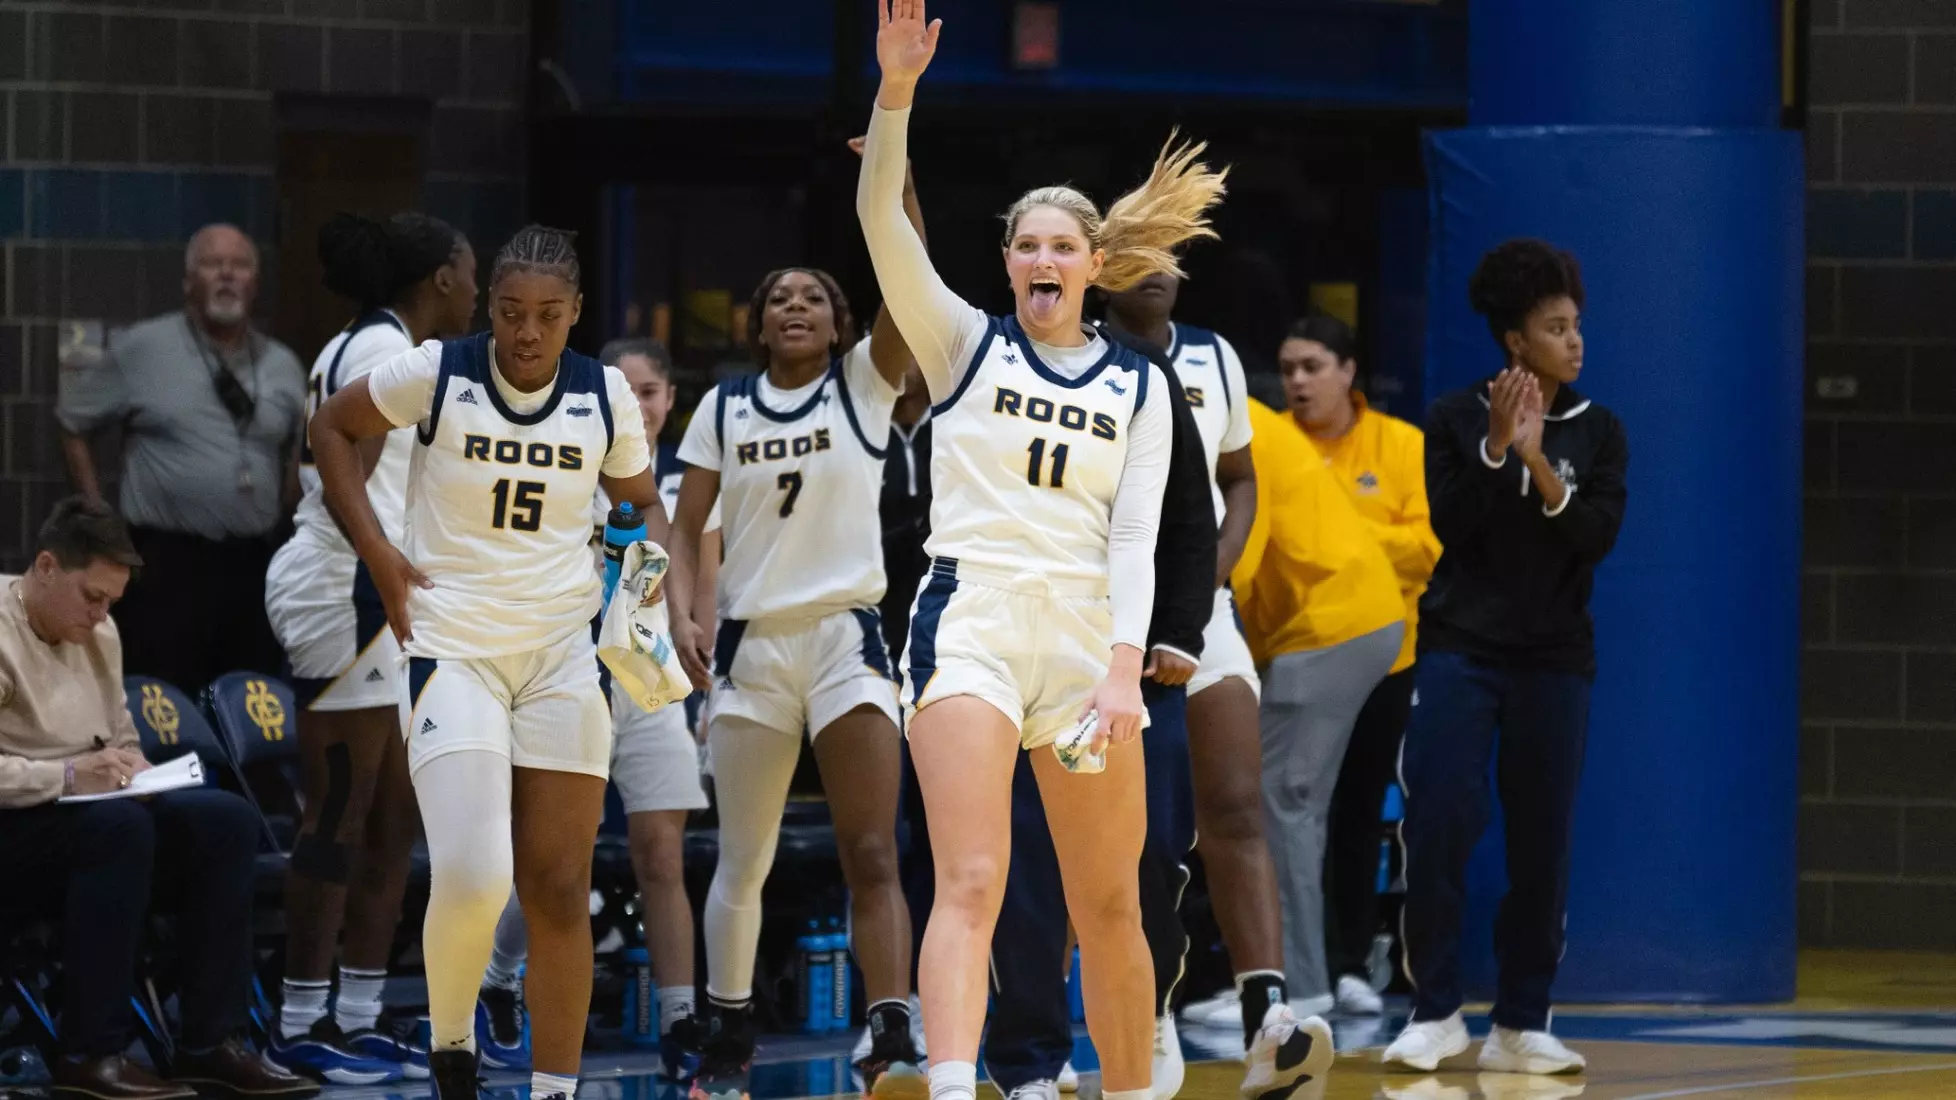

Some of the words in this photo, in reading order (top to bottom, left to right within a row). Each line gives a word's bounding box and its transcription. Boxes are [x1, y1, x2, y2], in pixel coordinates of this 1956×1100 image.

[994, 384, 1117, 442] ROOS
[463, 432, 583, 471] ROOS
[737, 427, 831, 466] ROOS
[1027, 436, 1069, 488] 11
[491, 477, 546, 533] 15
[777, 470, 803, 519] 7
